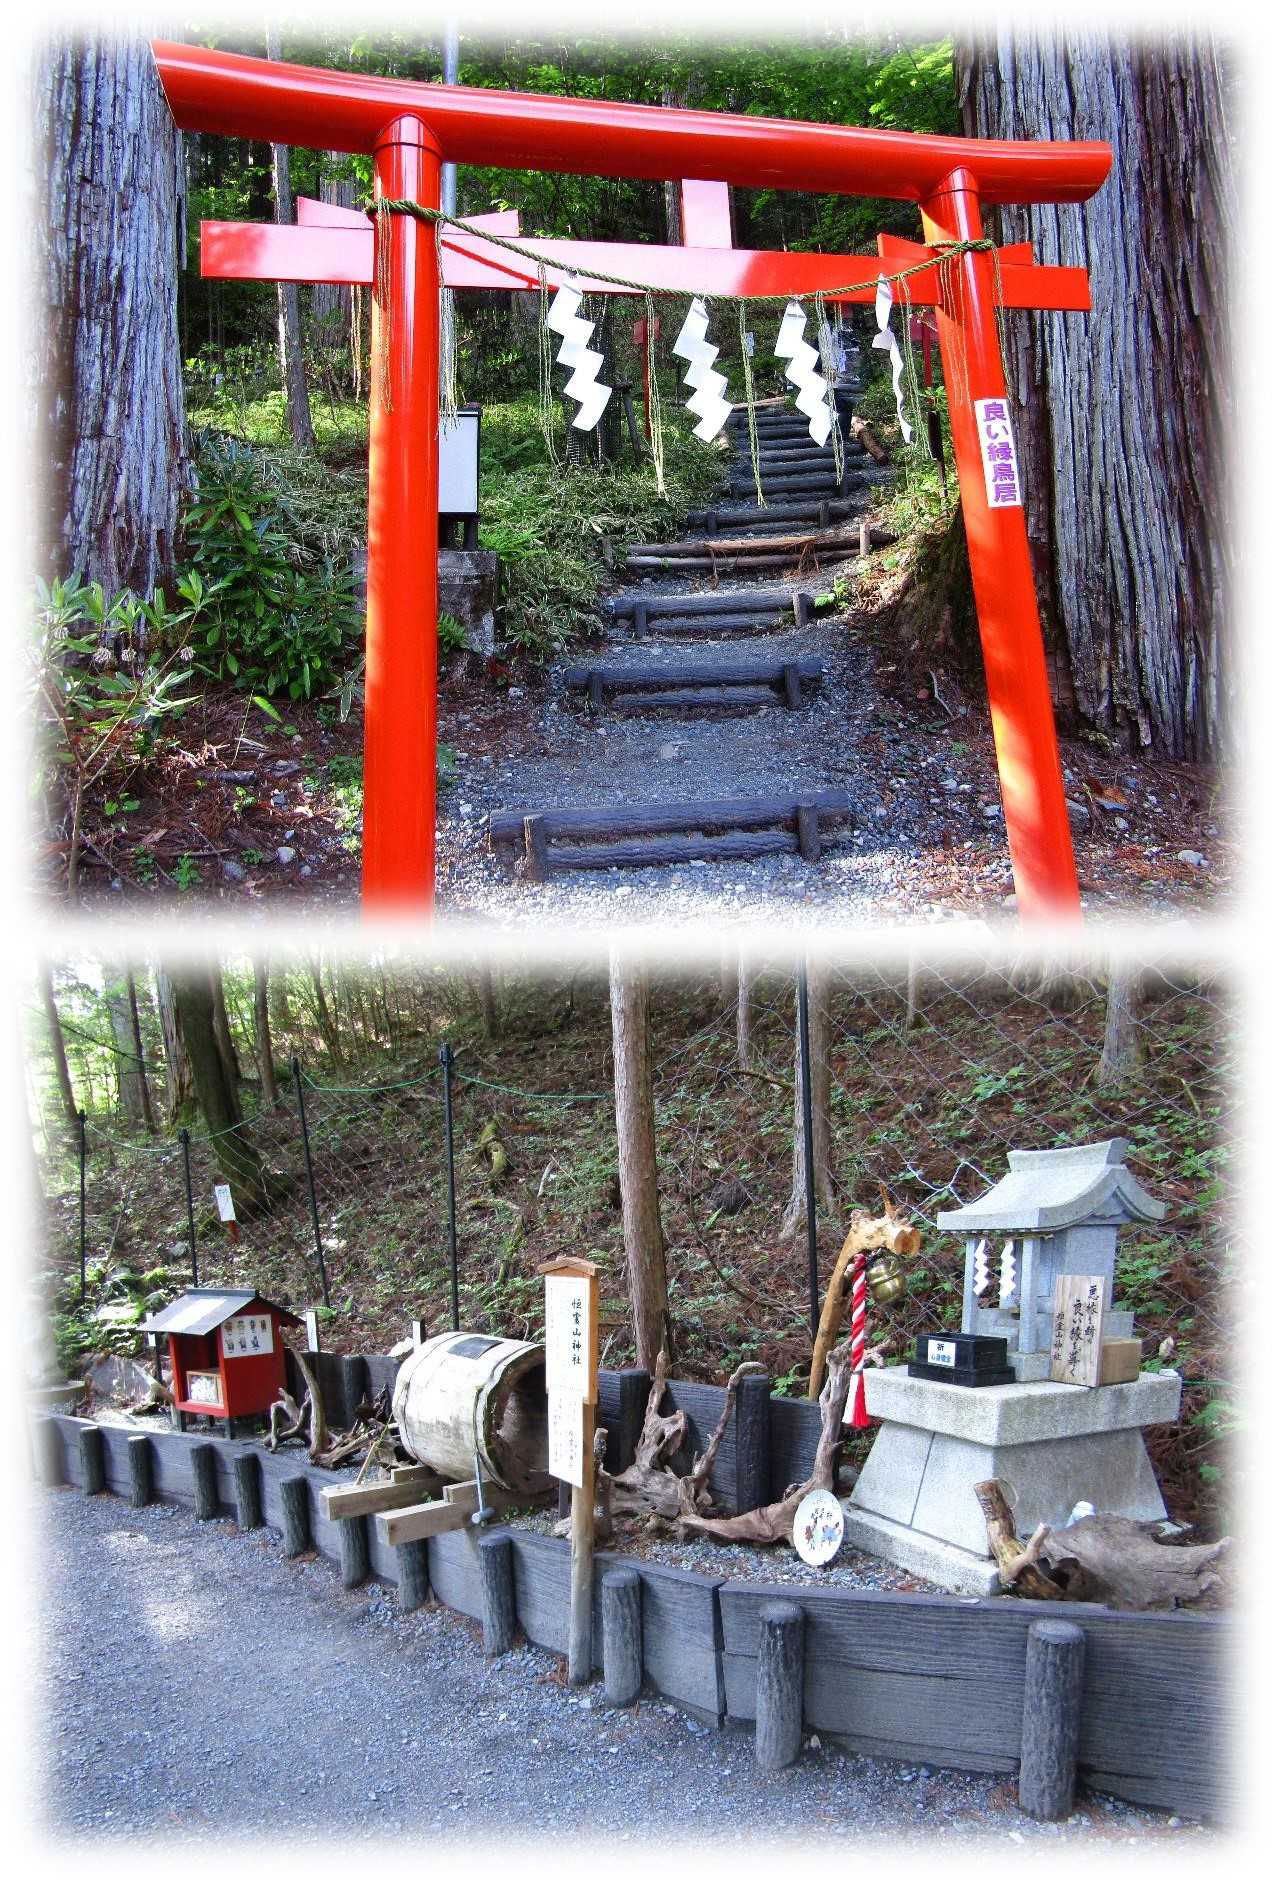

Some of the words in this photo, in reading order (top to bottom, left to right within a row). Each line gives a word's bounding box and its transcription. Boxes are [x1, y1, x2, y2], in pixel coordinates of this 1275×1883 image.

[983, 401, 1017, 503] 良い縁鳥居
